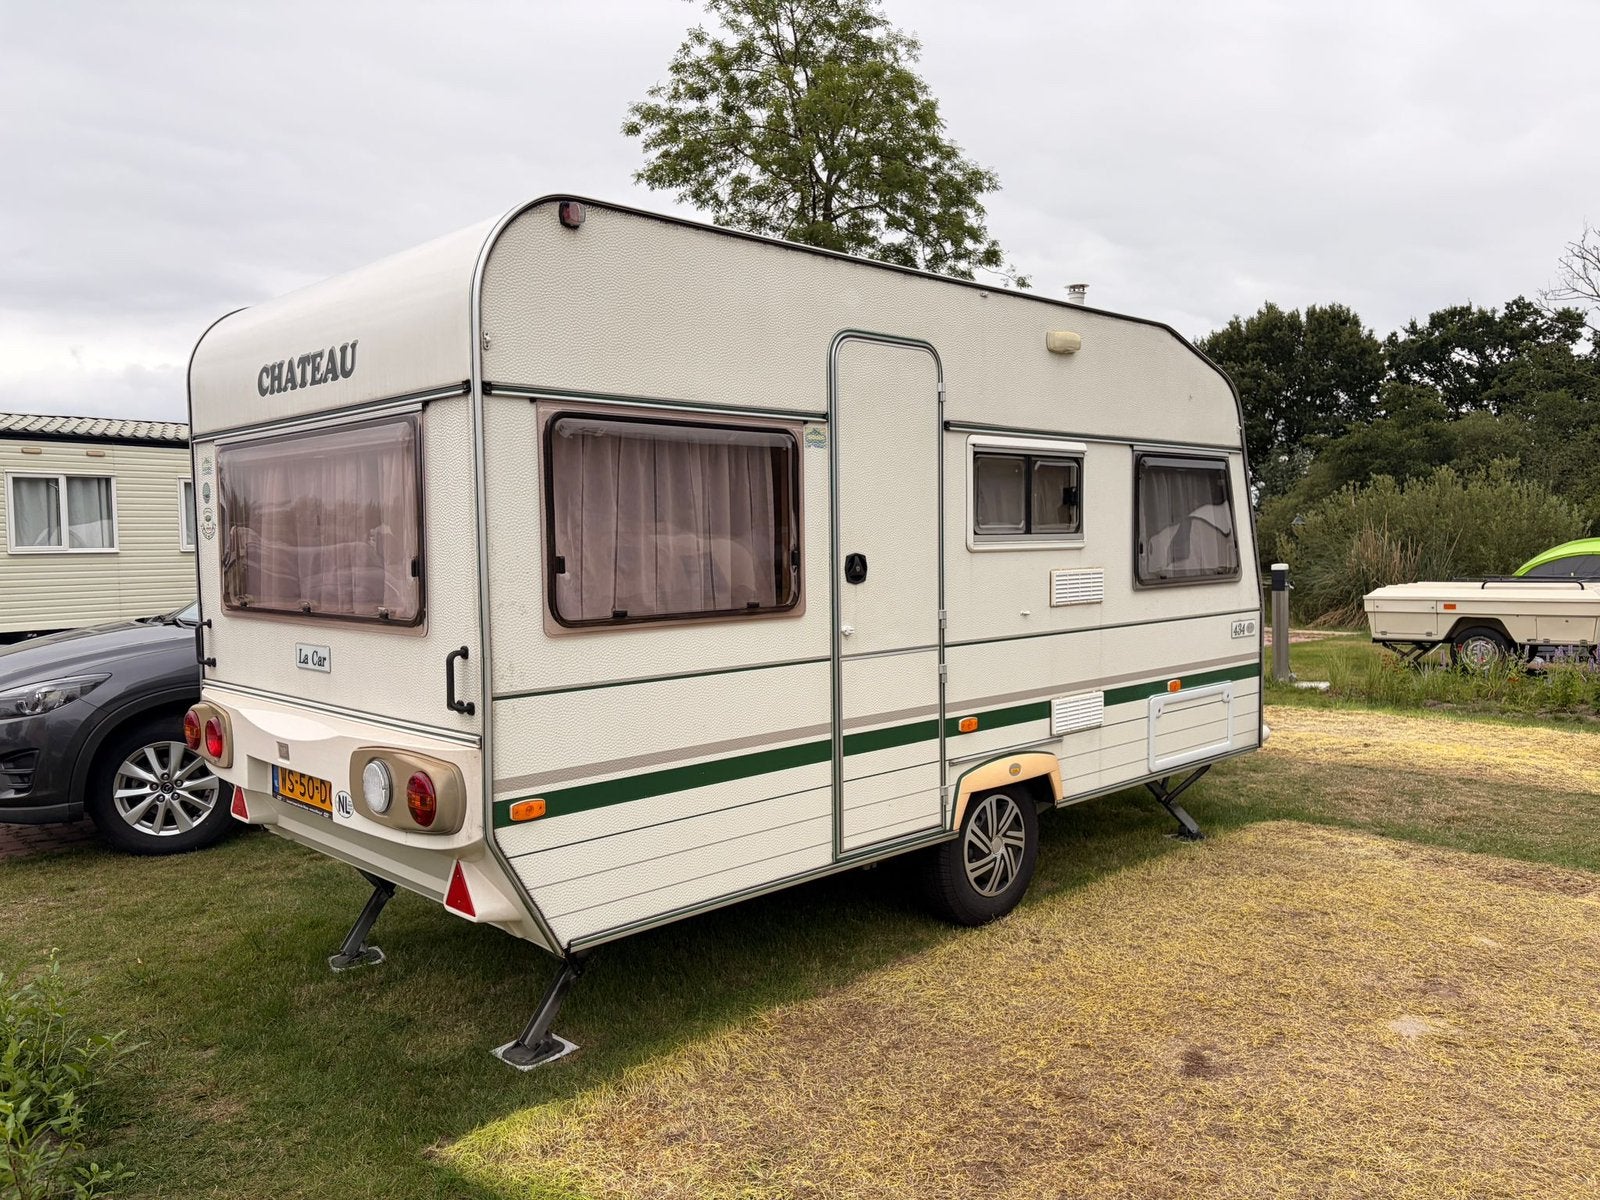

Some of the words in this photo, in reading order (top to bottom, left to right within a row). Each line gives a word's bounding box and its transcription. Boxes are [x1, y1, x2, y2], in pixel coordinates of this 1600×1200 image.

[257, 339, 359, 397] CHATEAU
[1233, 622, 1246, 636] 434
[298, 648, 309, 665] La
[311, 650, 327, 667] Car
[280, 766, 333, 806] WS-50-D
[337, 794, 351, 815] NL
